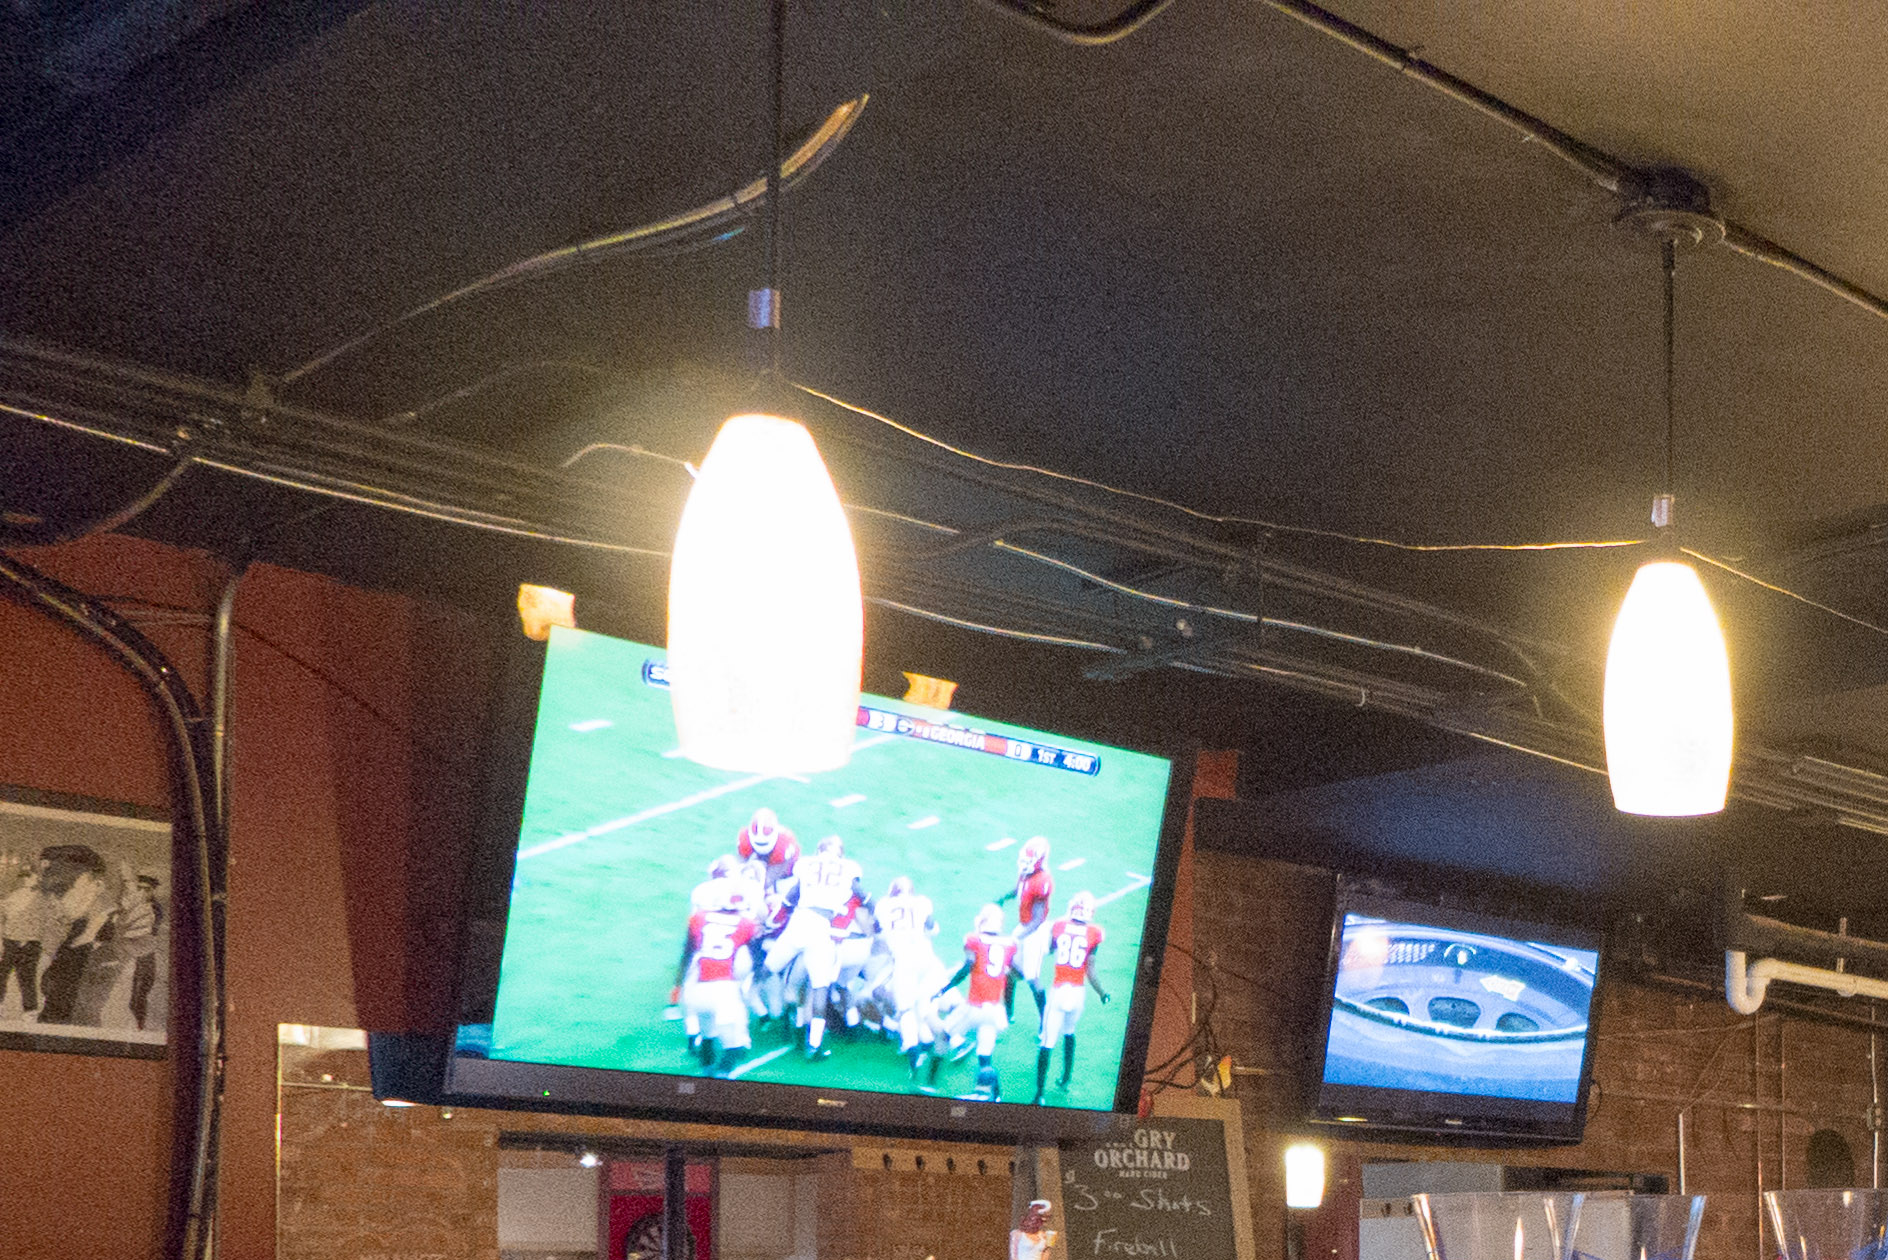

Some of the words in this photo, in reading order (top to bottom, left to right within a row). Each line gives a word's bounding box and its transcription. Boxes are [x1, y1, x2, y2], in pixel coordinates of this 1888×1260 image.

[931, 725, 985, 750] GEORGIA
[1037, 749, 1056, 765] 1ST
[1063, 753, 1091, 772] 4:00
[1056, 933, 1088, 968] 86
[1094, 1149, 1190, 1172] ORCHARD
[1130, 1188, 1212, 1217] Shots
[1093, 1228, 1178, 1258] Fireball
